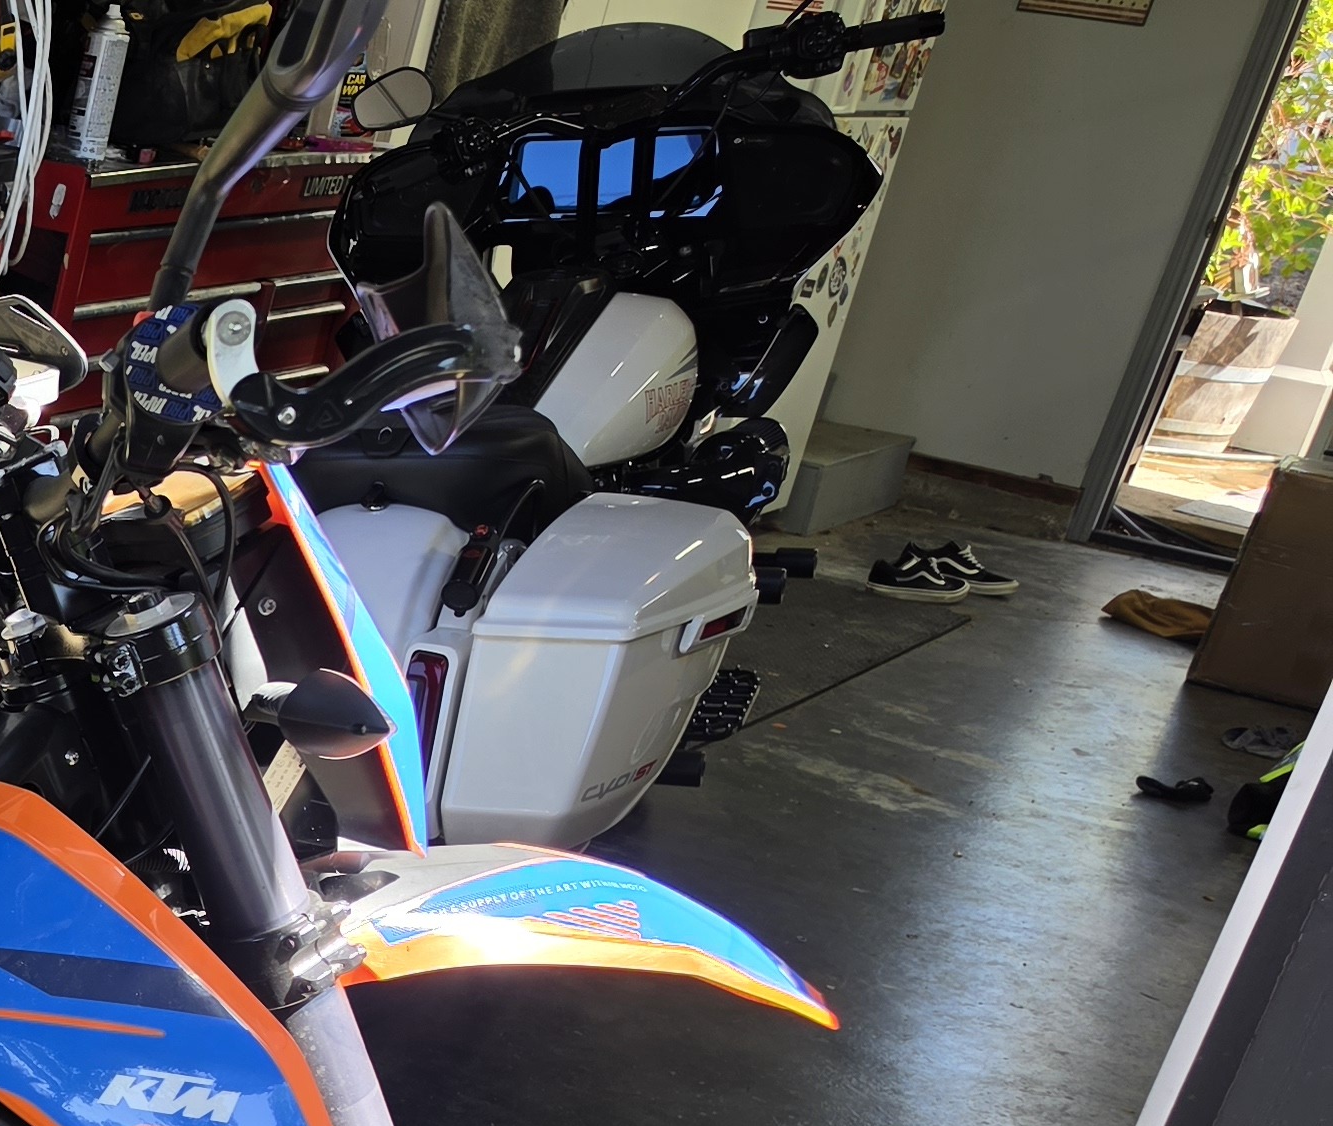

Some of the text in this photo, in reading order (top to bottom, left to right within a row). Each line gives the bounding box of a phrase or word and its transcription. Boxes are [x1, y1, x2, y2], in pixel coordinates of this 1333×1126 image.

[342, 85, 365, 95] WA
[347, 74, 367, 85] CAR
[304, 175, 344, 196] LIMITED
[460, 893, 509, 911] SUPPLY
[509, 890, 527, 901] OF
[527, 885, 554, 897] THE
[555, 882, 578, 893] ART
[96, 1069, 242, 1124] KTM
